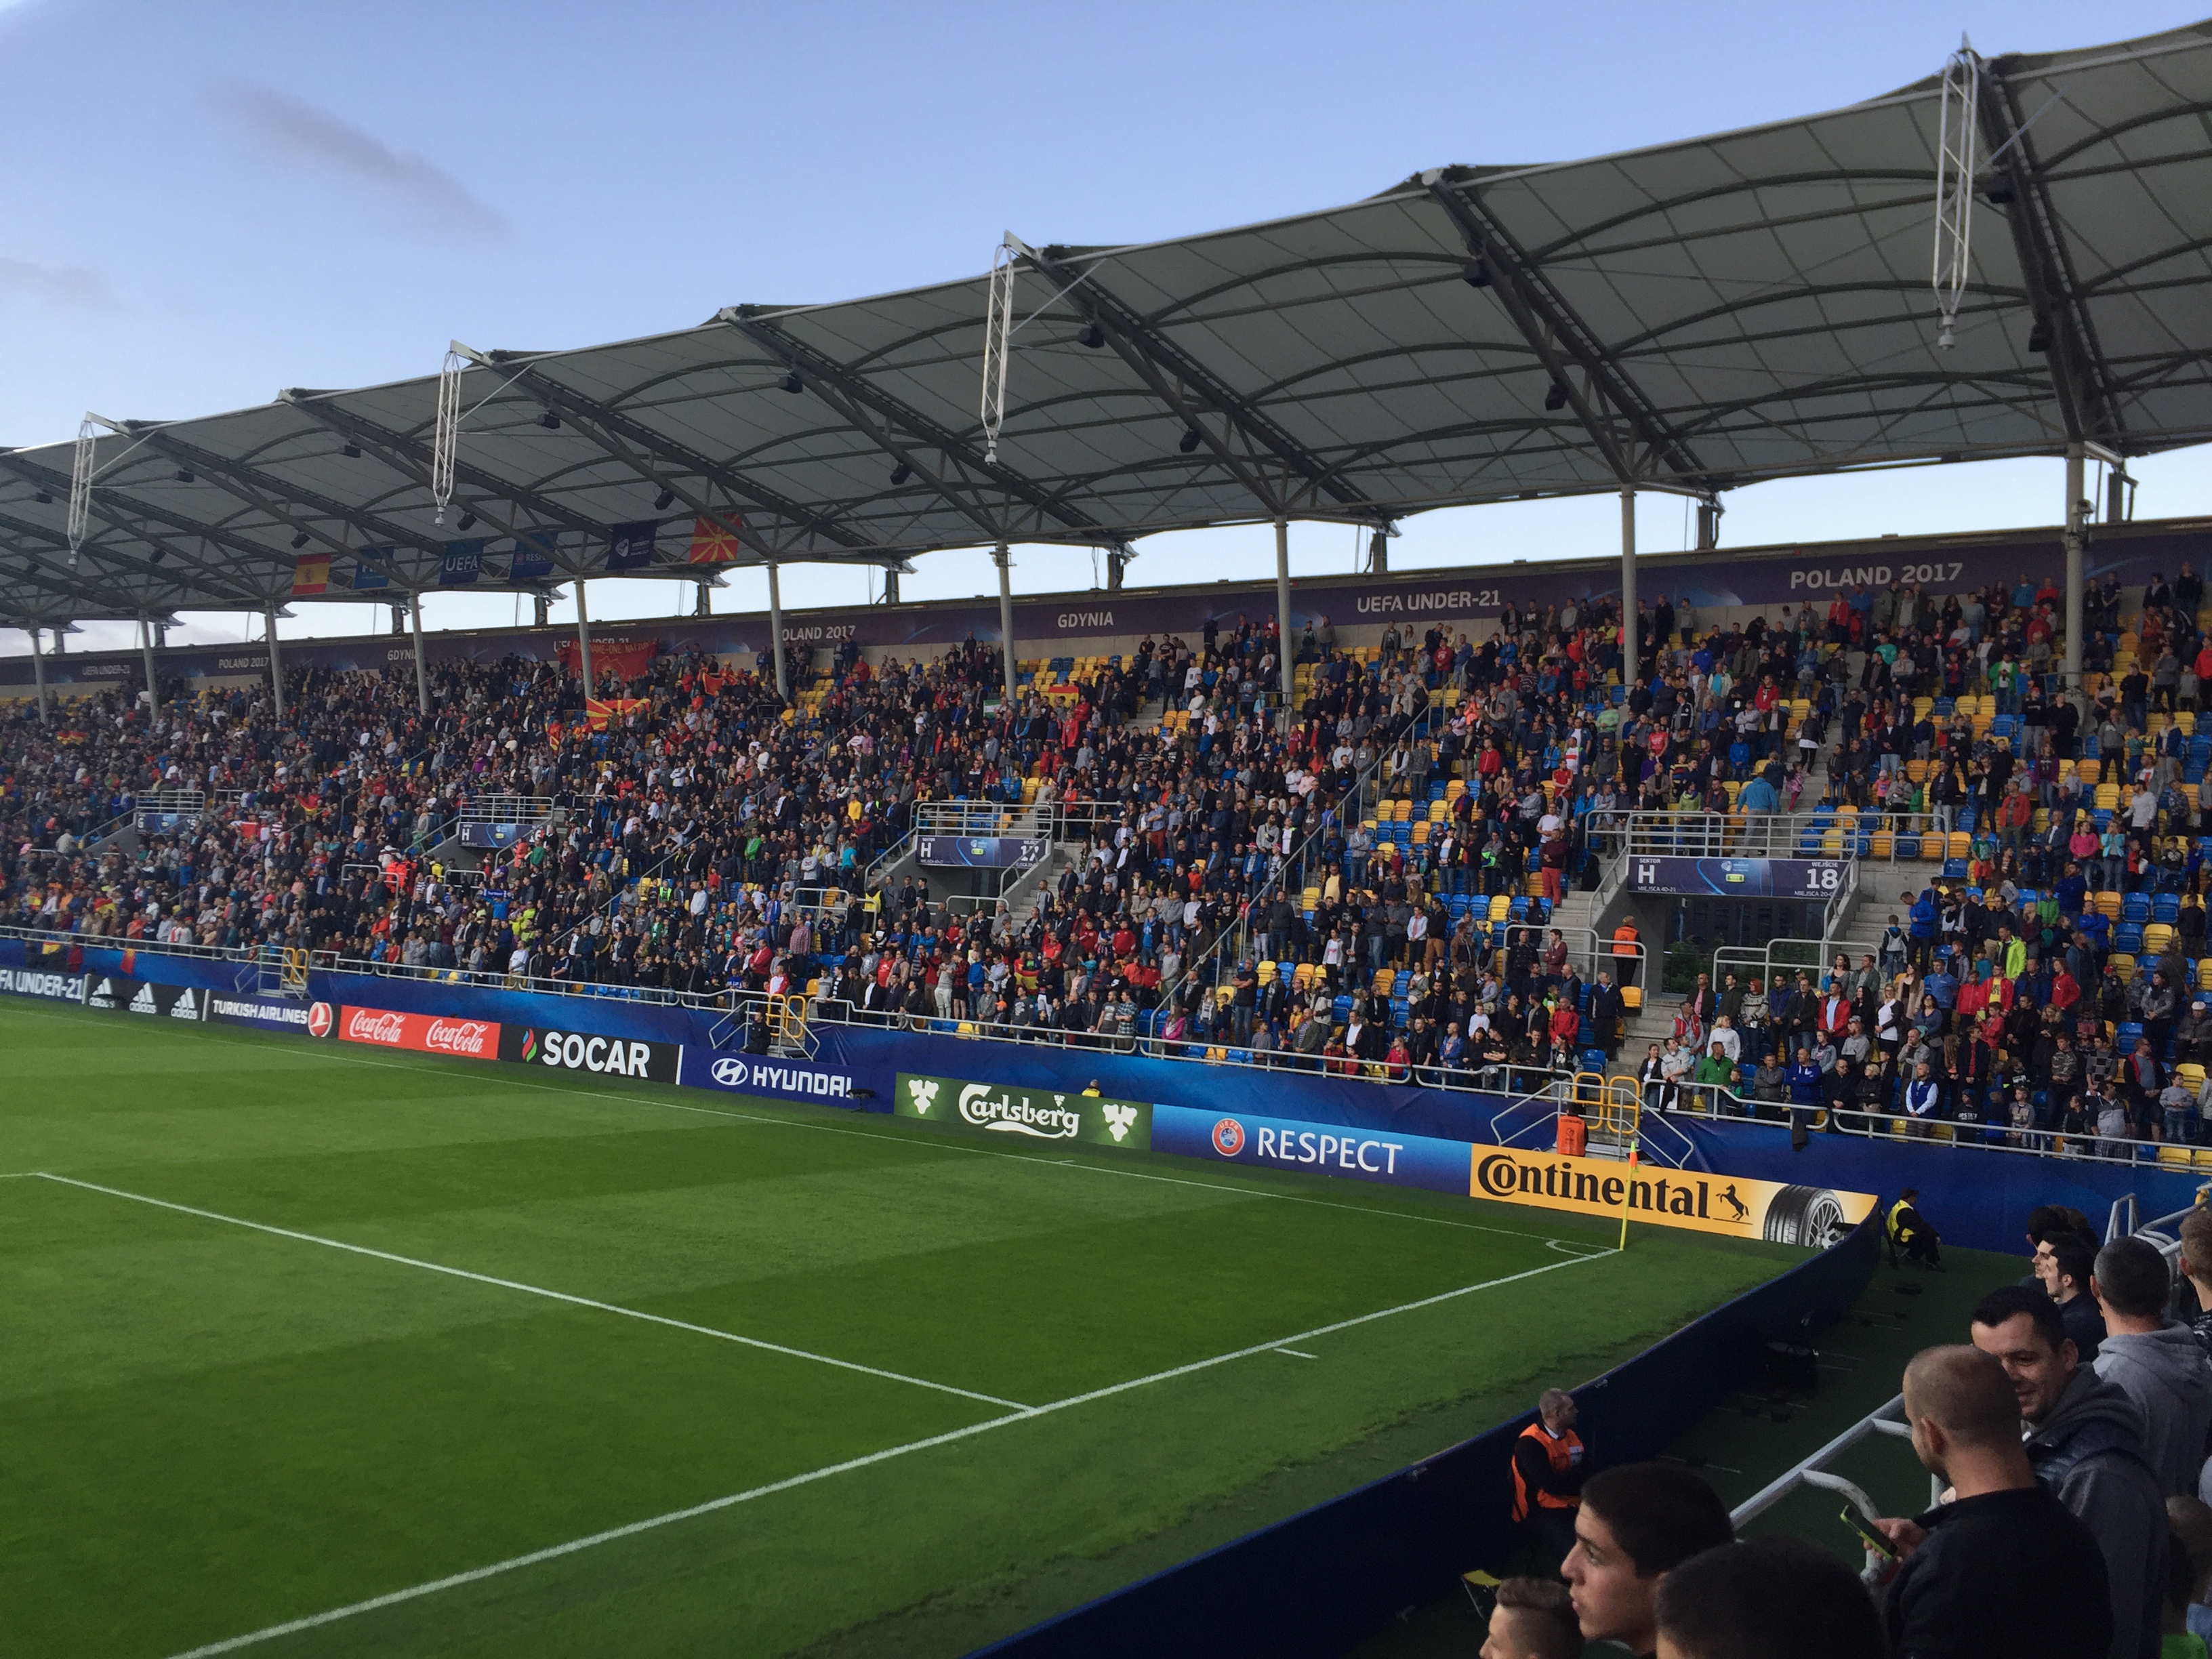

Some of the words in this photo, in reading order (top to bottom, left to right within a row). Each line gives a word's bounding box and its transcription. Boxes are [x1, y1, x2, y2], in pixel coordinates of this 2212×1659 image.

[445, 554, 478, 572] UEFA
[1790, 566, 1892, 590] POLAND
[1900, 562, 1963, 583] 2017
[1357, 594, 1404, 613] UEFA
[1407, 590, 1501, 610] UNDER-21
[1057, 611, 1115, 629] GDYNIA
[782, 626, 823, 641] OLAND
[826, 625, 856, 639] 2017
[218, 657, 249, 669] POLAND
[250, 656, 270, 668] 2017
[462, 827, 470, 842] H
[920, 842, 932, 858] H
[1020, 845, 1040, 861] 17
[1637, 864, 1655, 884] H
[1806, 868, 1838, 890] 18
[15, 971, 83, 1000] UNDER-21
[129, 1001, 158, 1015] adidas
[170, 1006, 199, 1020] adidas
[213, 1000, 259, 1018] TURKISH
[258, 1005, 308, 1025] AIRLINES
[541, 1031, 651, 1079] SOCAR
[958, 1083, 1080, 1139] Carlsberg
[1257, 1126, 1404, 1174] RESPECT
[1477, 1153, 1711, 1220] Continental
